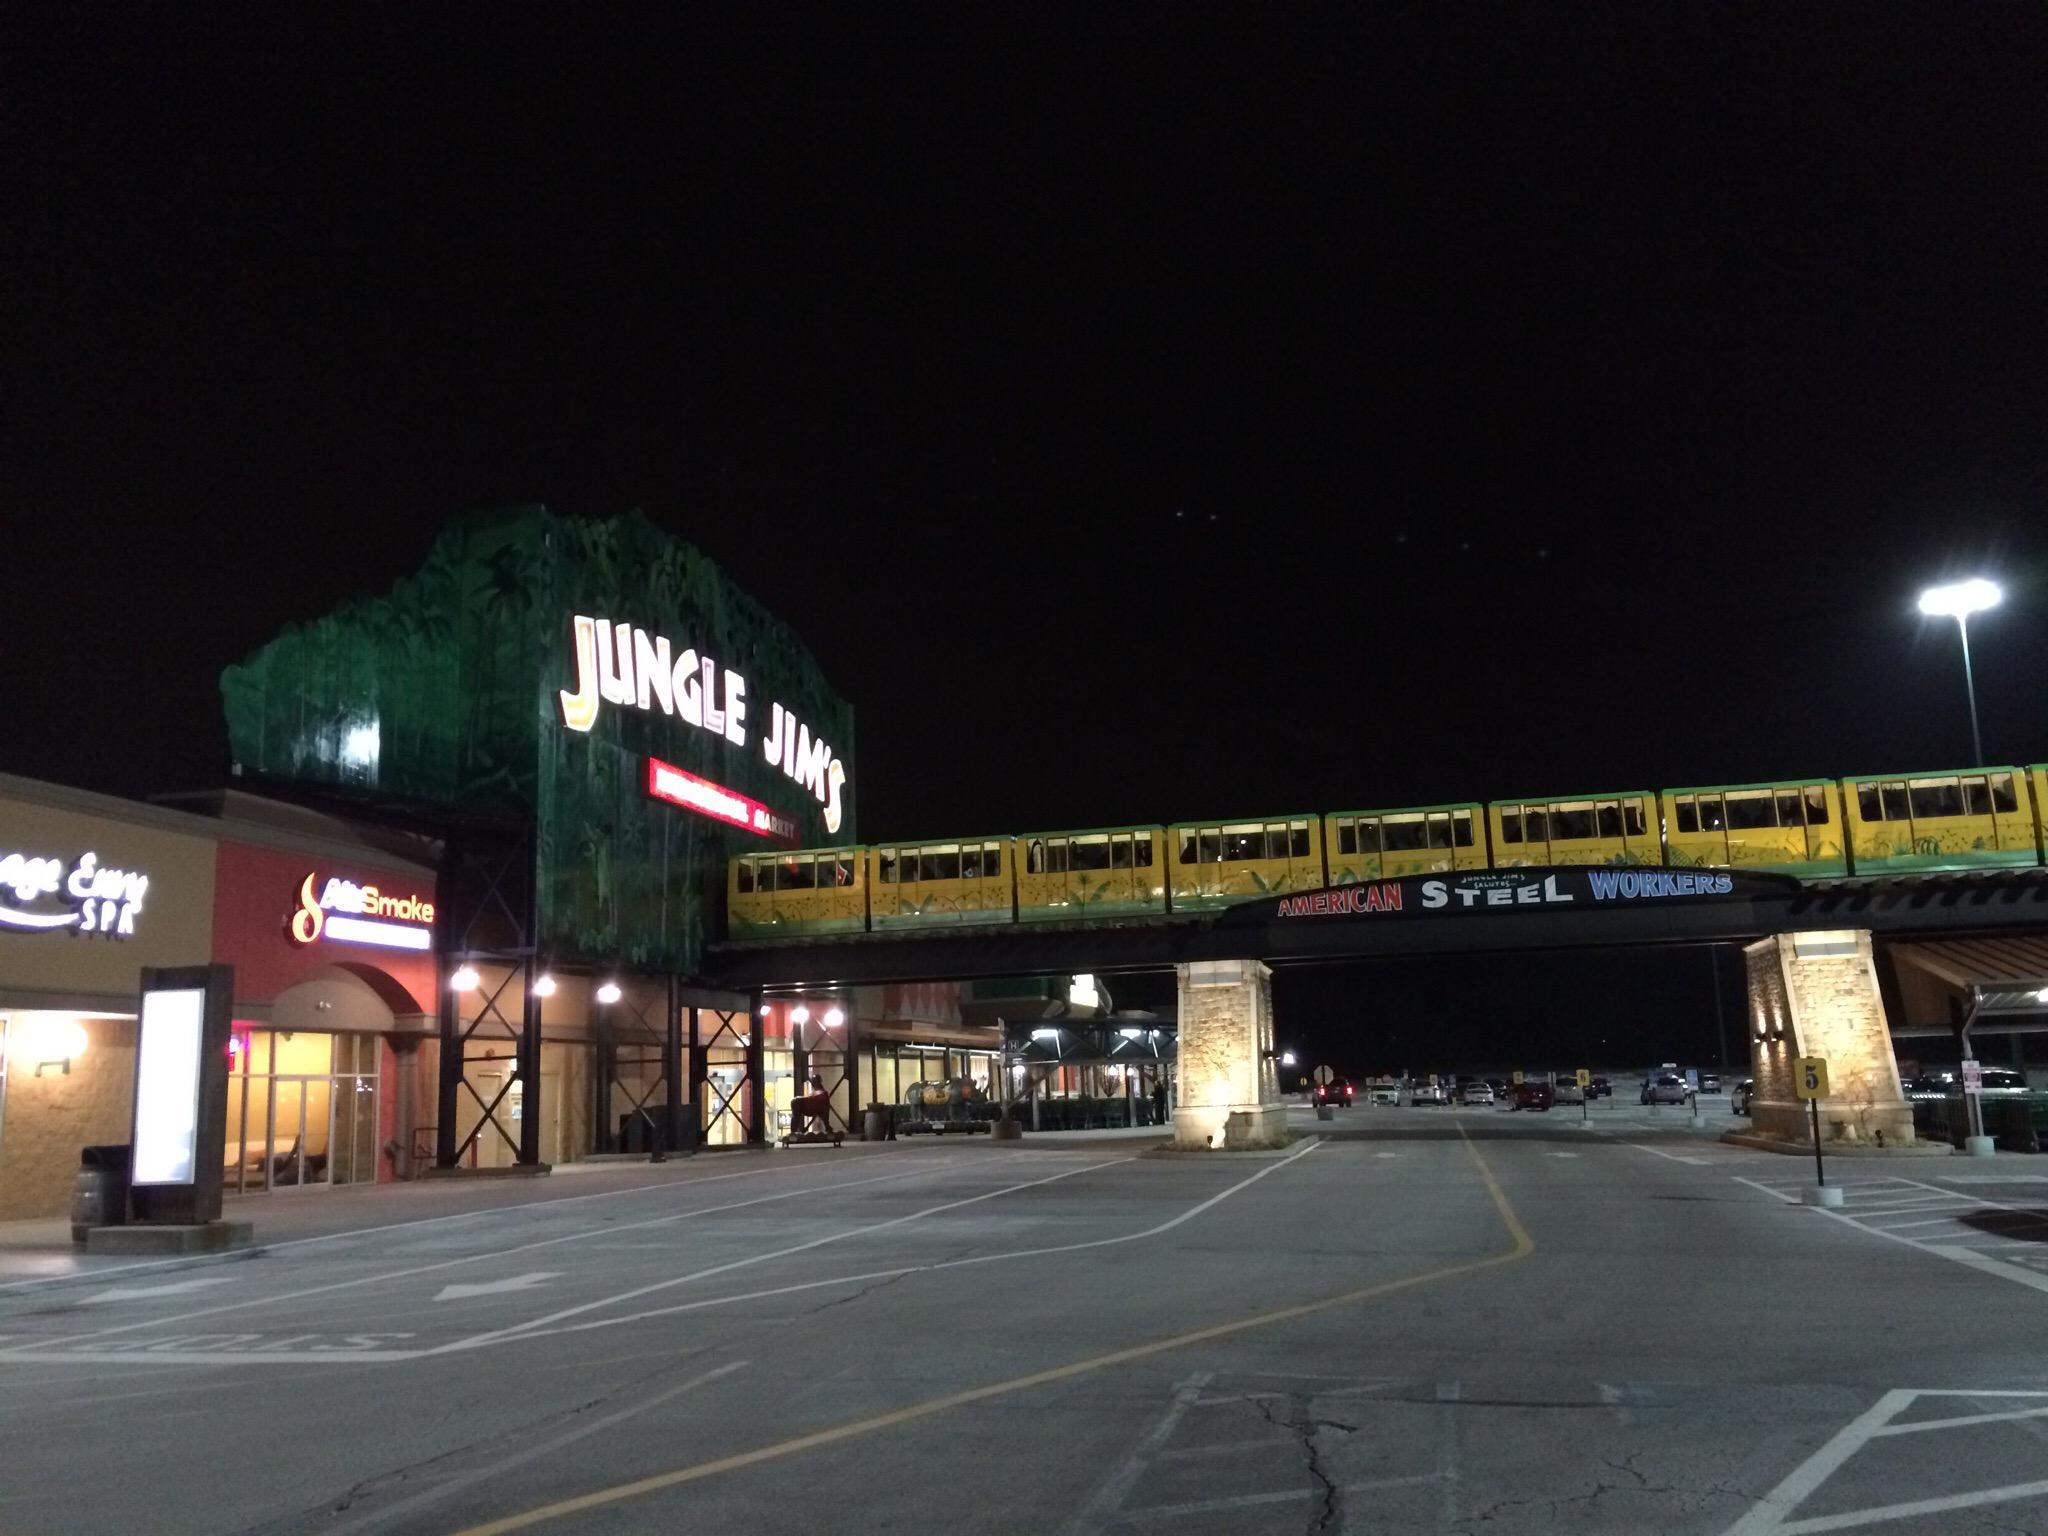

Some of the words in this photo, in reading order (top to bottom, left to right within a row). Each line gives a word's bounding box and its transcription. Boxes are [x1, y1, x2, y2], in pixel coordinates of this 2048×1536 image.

[560, 614, 746, 746] JUNGLE
[764, 702, 846, 833] JIM'S
[68, 852, 148, 913] Envy
[1278, 883, 1403, 917] AMERICAN
[1422, 875, 1574, 908] STEEL
[1588, 870, 1733, 900] WORKERS
[81, 898, 133, 933] SPA
[1806, 1065, 1819, 1090] 5
